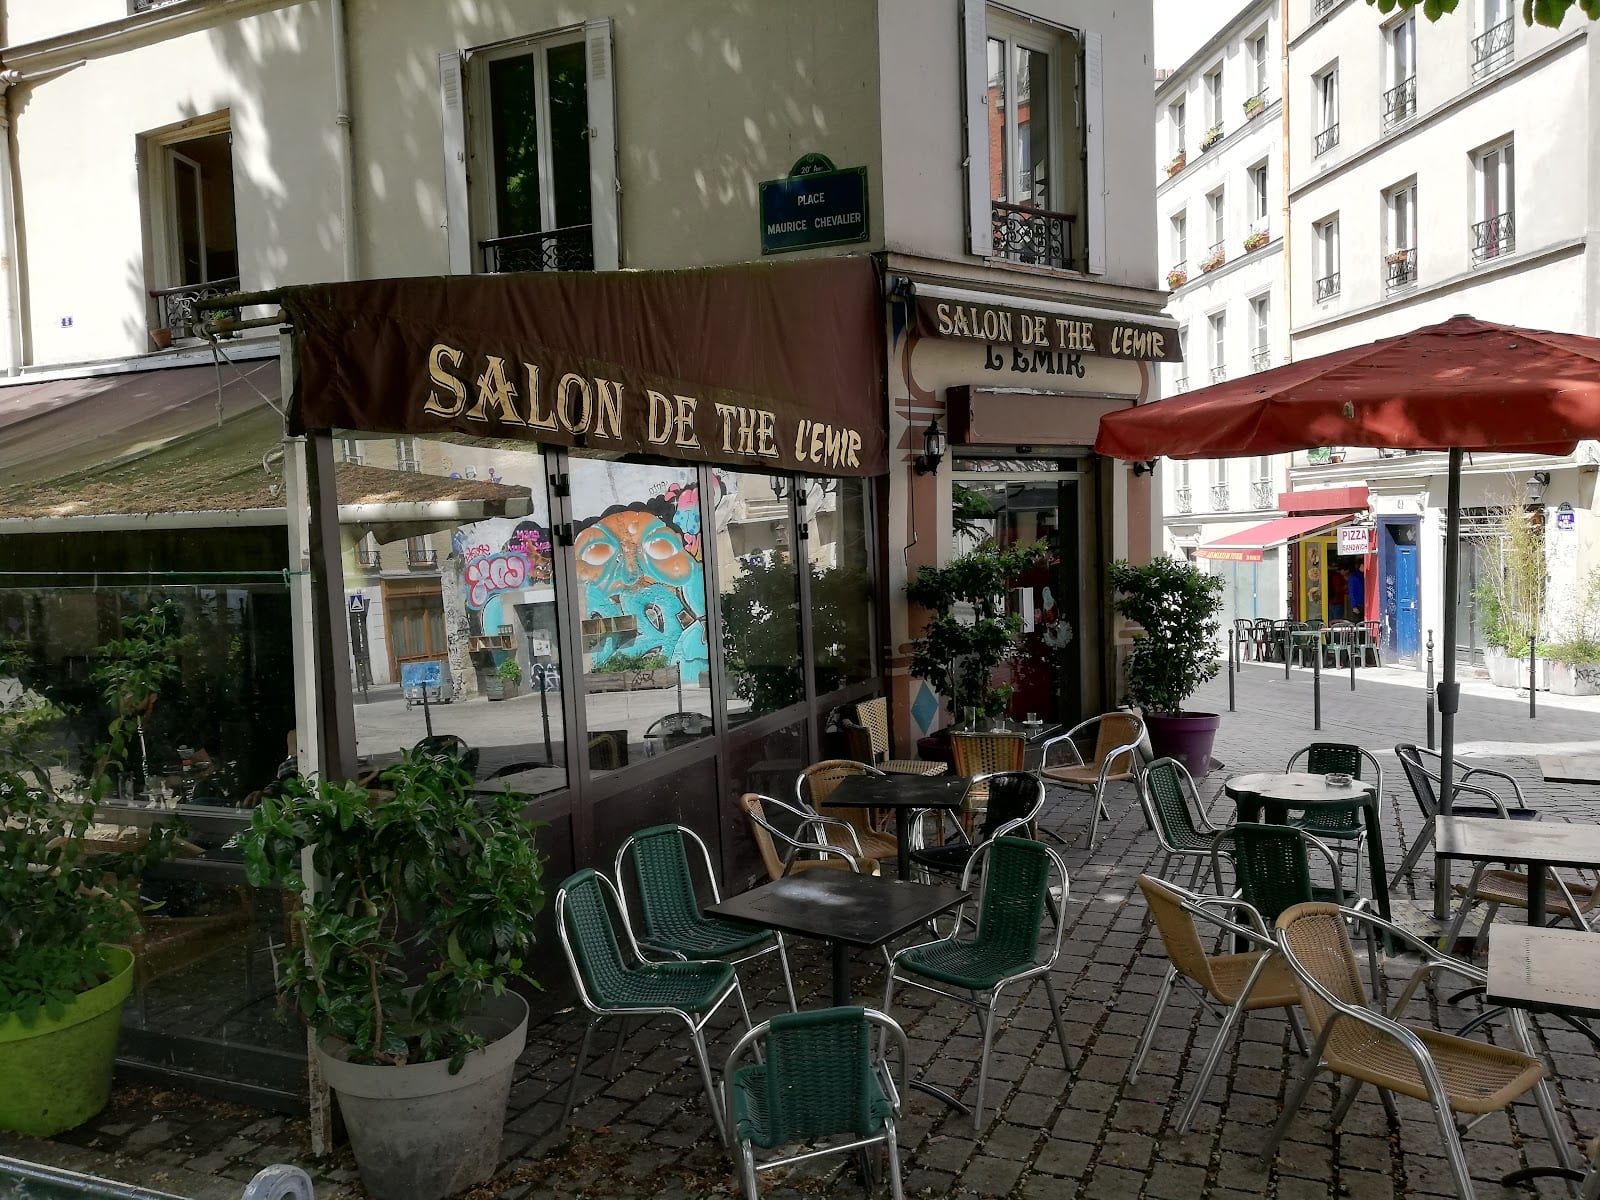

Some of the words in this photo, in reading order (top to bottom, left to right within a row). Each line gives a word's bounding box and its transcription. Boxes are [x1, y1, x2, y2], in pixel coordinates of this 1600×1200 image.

[797, 192, 825, 206] PLACE
[767, 220, 807, 235] MAURICE
[814, 212, 861, 228] CHEVALIER
[937, 304, 1013, 341] SALON
[1021, 315, 1050, 346] DE
[1056, 319, 1095, 351] THE
[1111, 326, 1165, 358] L'EMIR
[423, 343, 626, 441] SALON
[647, 389, 702, 450] DE
[715, 401, 779, 458] THE
[795, 418, 862, 469] L'EMIR
[1342, 530, 1367, 541] PIZZA
